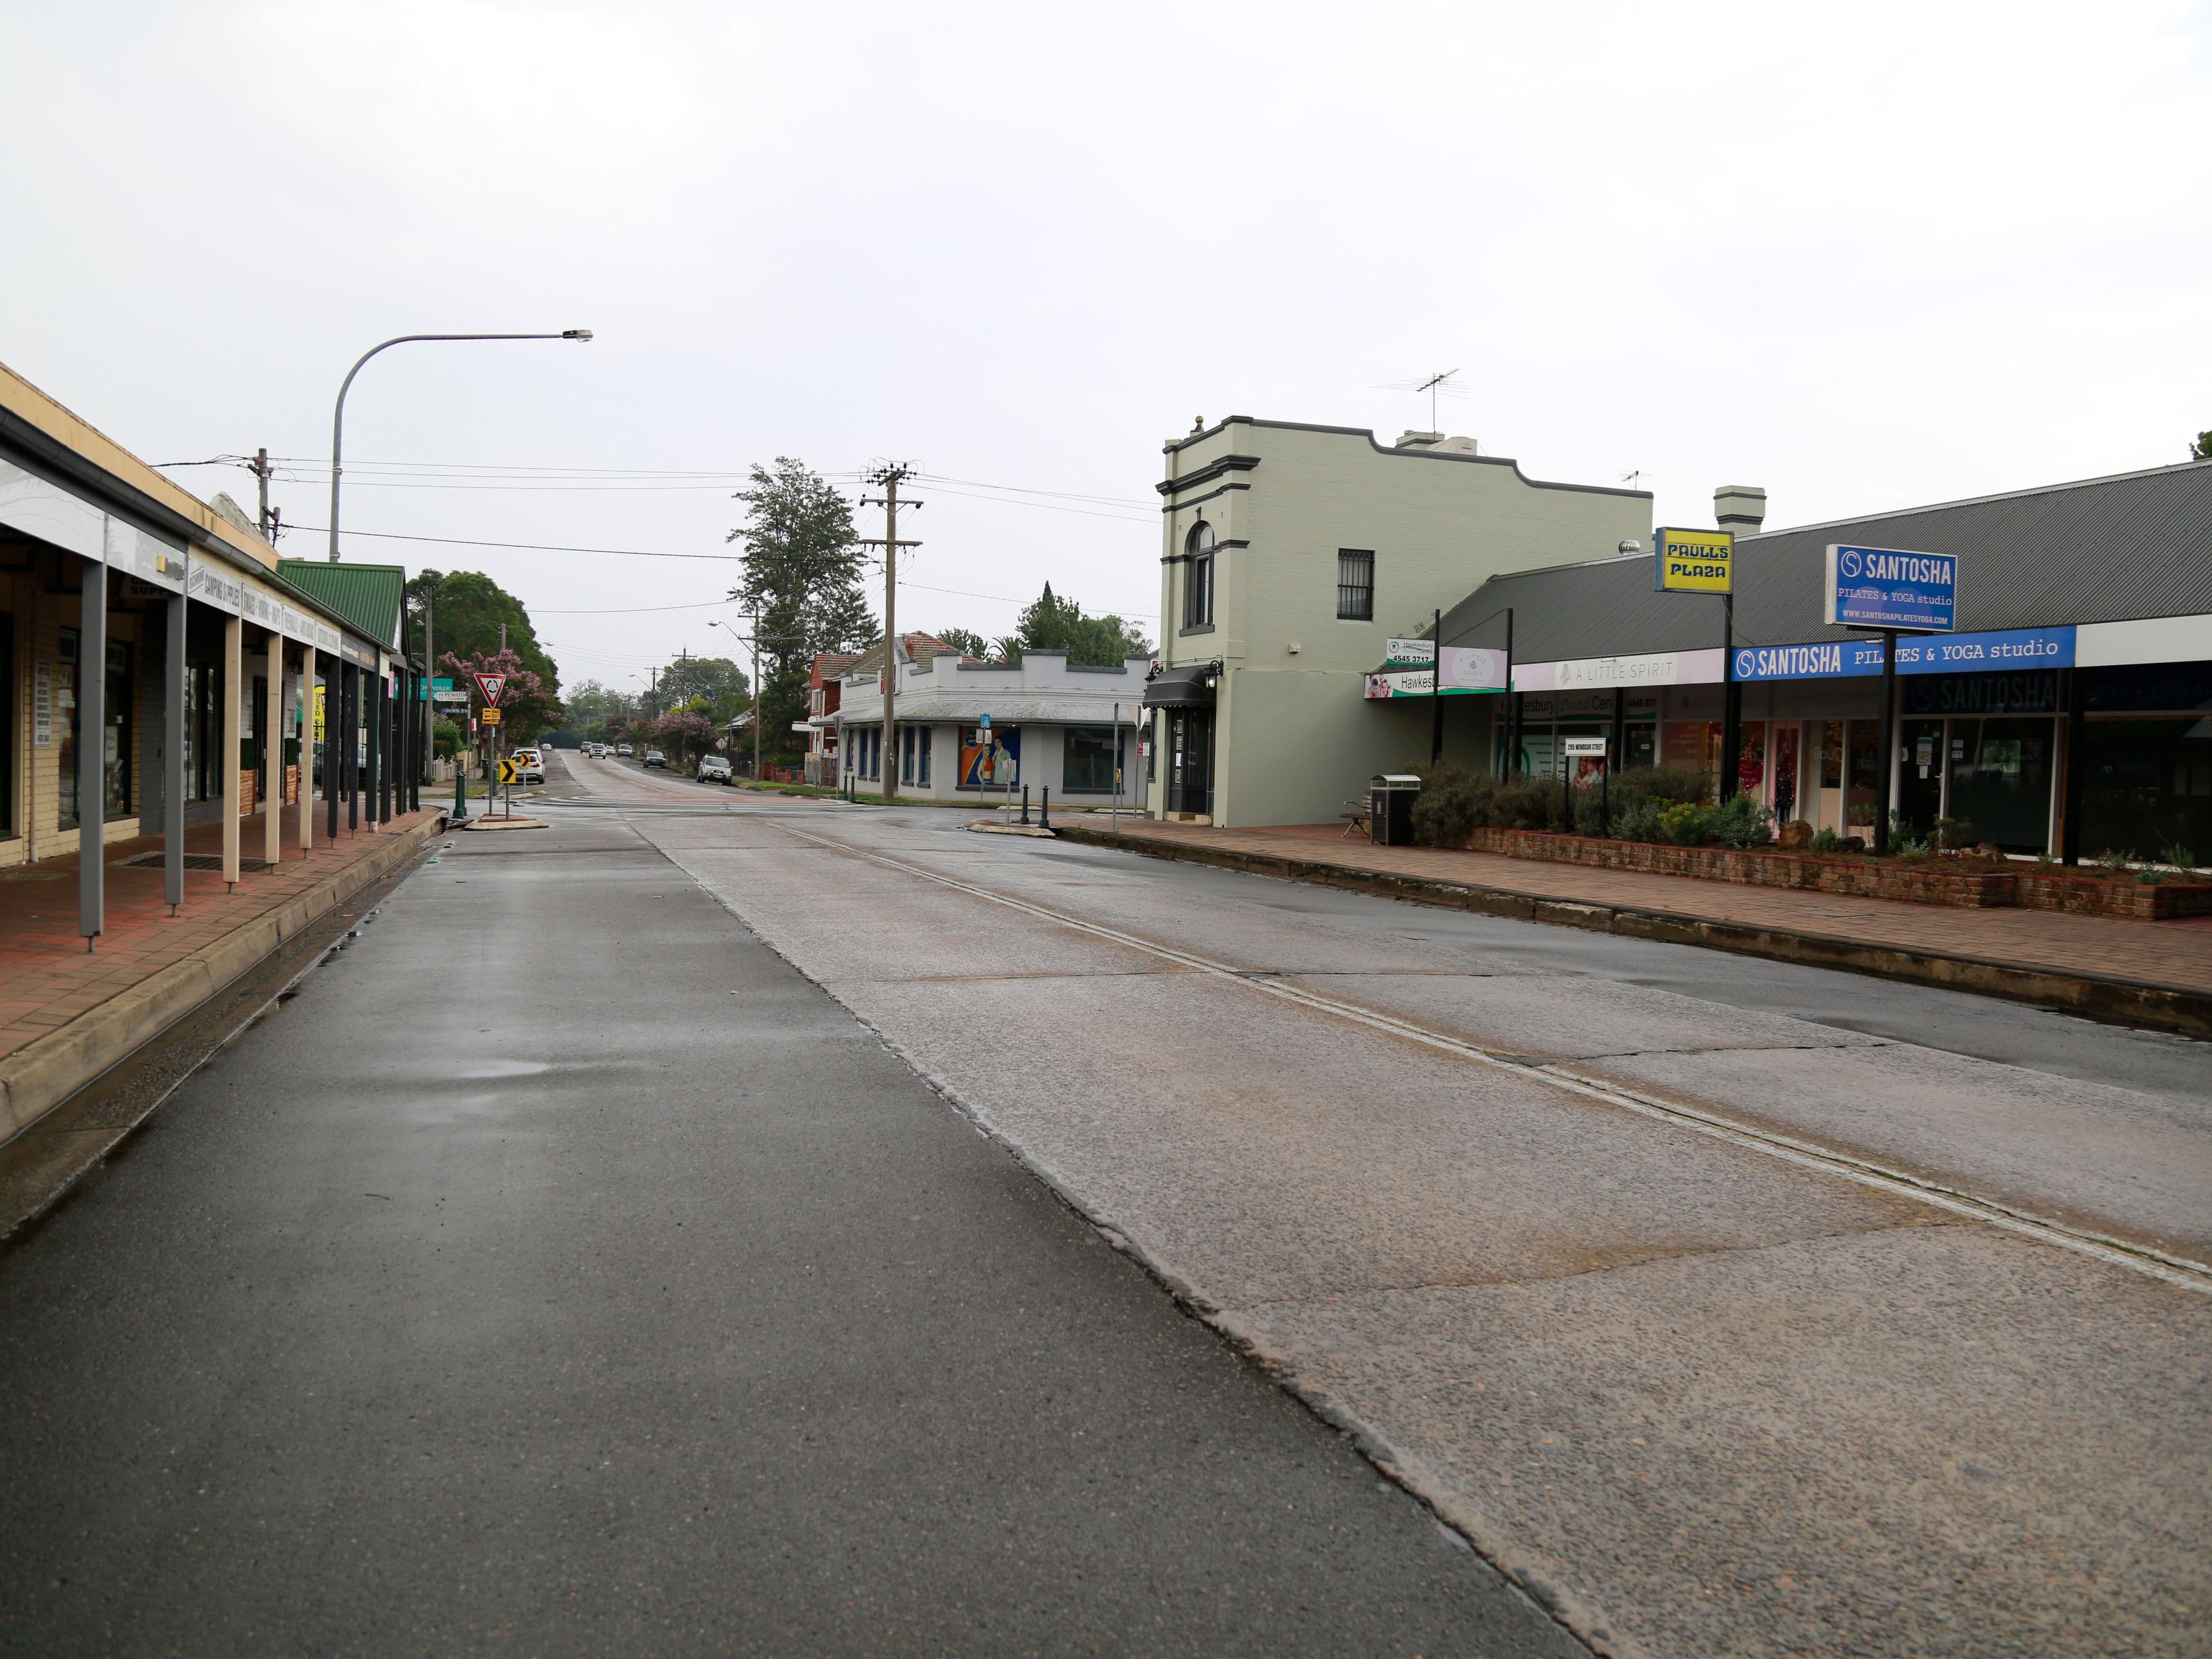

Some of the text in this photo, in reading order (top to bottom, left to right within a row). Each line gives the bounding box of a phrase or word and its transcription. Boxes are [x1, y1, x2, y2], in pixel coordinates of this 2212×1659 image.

[1671, 563, 1725, 578] PLAZA
[1866, 554, 1951, 584] SANTOSHA
[1838, 588, 1952, 605] PILATES & YOGA studio
[1843, 609, 1948, 624] WWW.SANTOSHAPILATESYOGA.COM
[1466, 654, 1486, 665] LITTLE
[1758, 645, 1841, 676] SANTOSHA
[1854, 647, 1920, 665] PILTES
[1926, 648, 1936, 661] &
[1942, 645, 1985, 660] YOGA
[1990, 639, 2058, 658] studio
[1576, 662, 1673, 681] A LITTLE SPIRIT
[1401, 675, 1448, 690] Hawkes
[1644, 699, 1656, 707] 371
